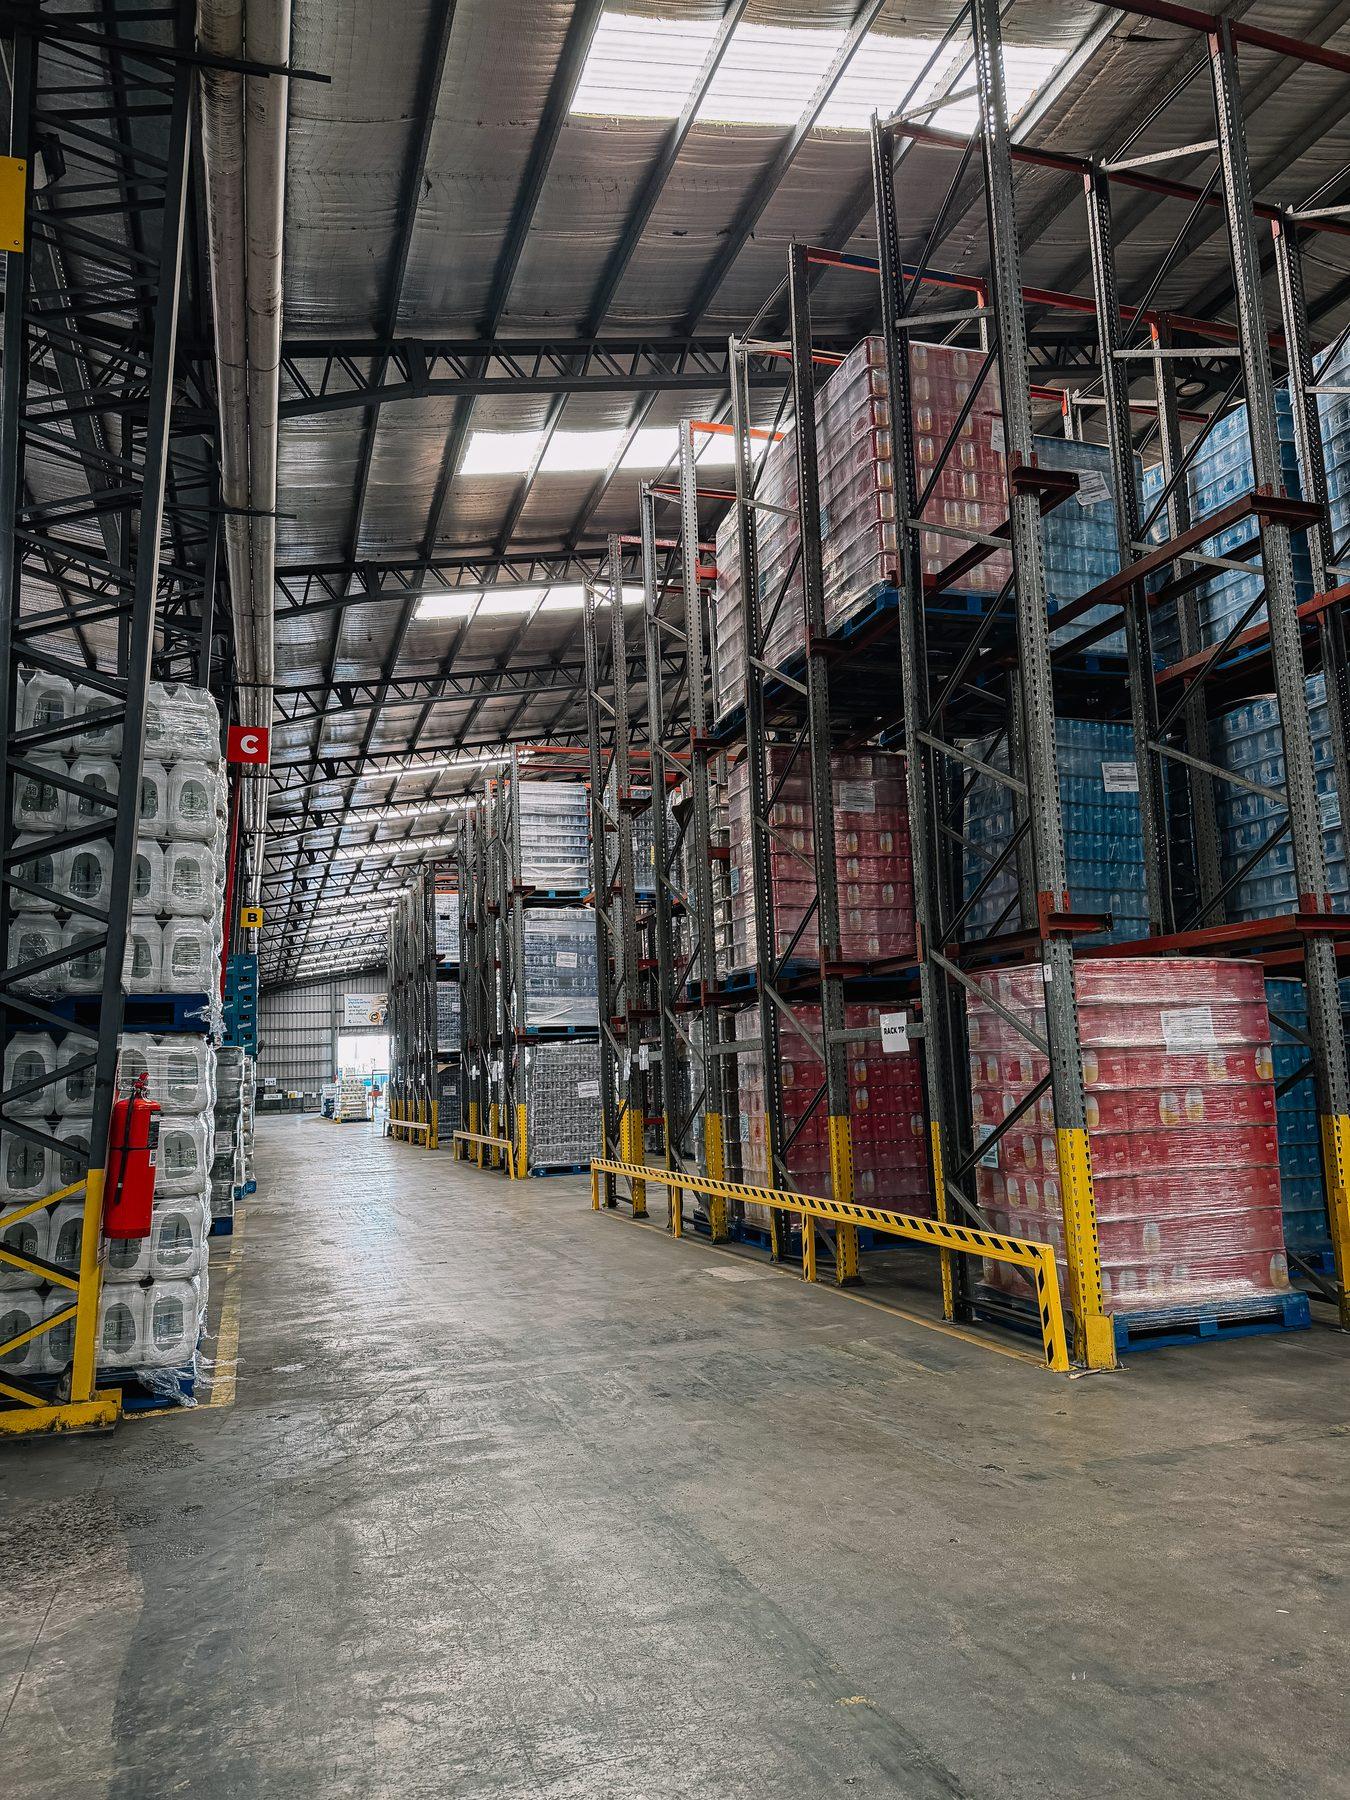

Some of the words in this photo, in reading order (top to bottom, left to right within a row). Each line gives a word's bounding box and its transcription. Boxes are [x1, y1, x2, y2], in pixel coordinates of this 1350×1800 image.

[240, 734, 259, 754] C
[247, 912, 258, 923] B
[883, 1026, 898, 1035] RACK
